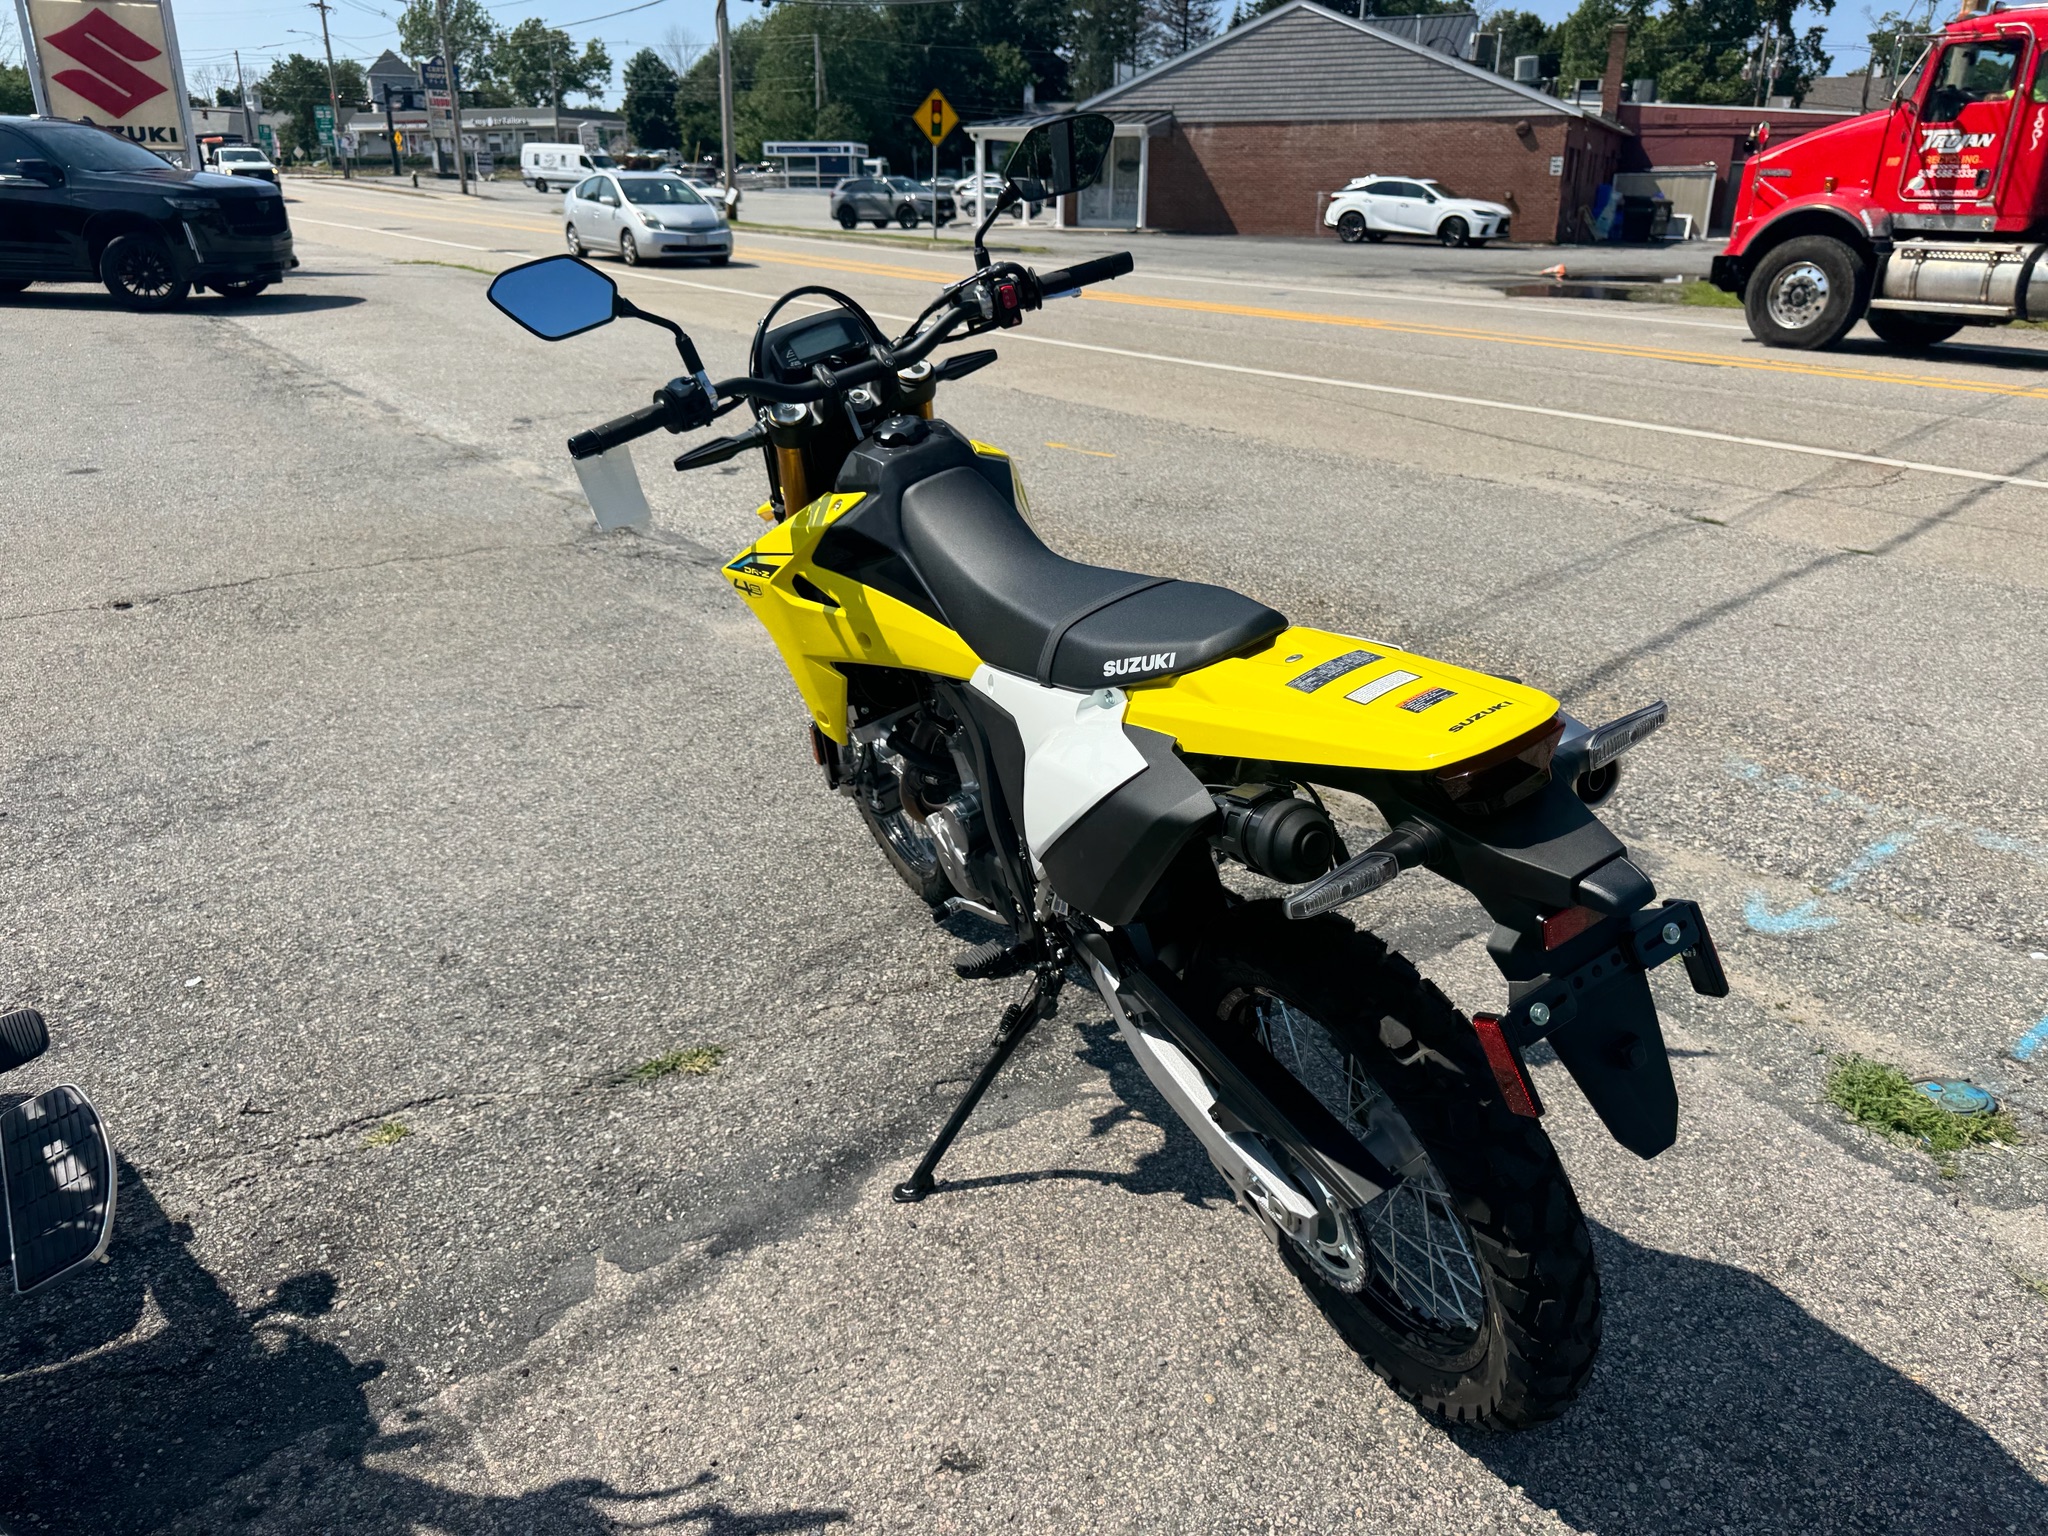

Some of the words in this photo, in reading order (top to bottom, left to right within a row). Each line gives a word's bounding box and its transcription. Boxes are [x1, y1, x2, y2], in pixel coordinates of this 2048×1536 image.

[1919, 129, 1996, 153] TROJAN
[1103, 652, 1176, 677] SUZUKI
[1448, 701, 1514, 733] SUZUKI
